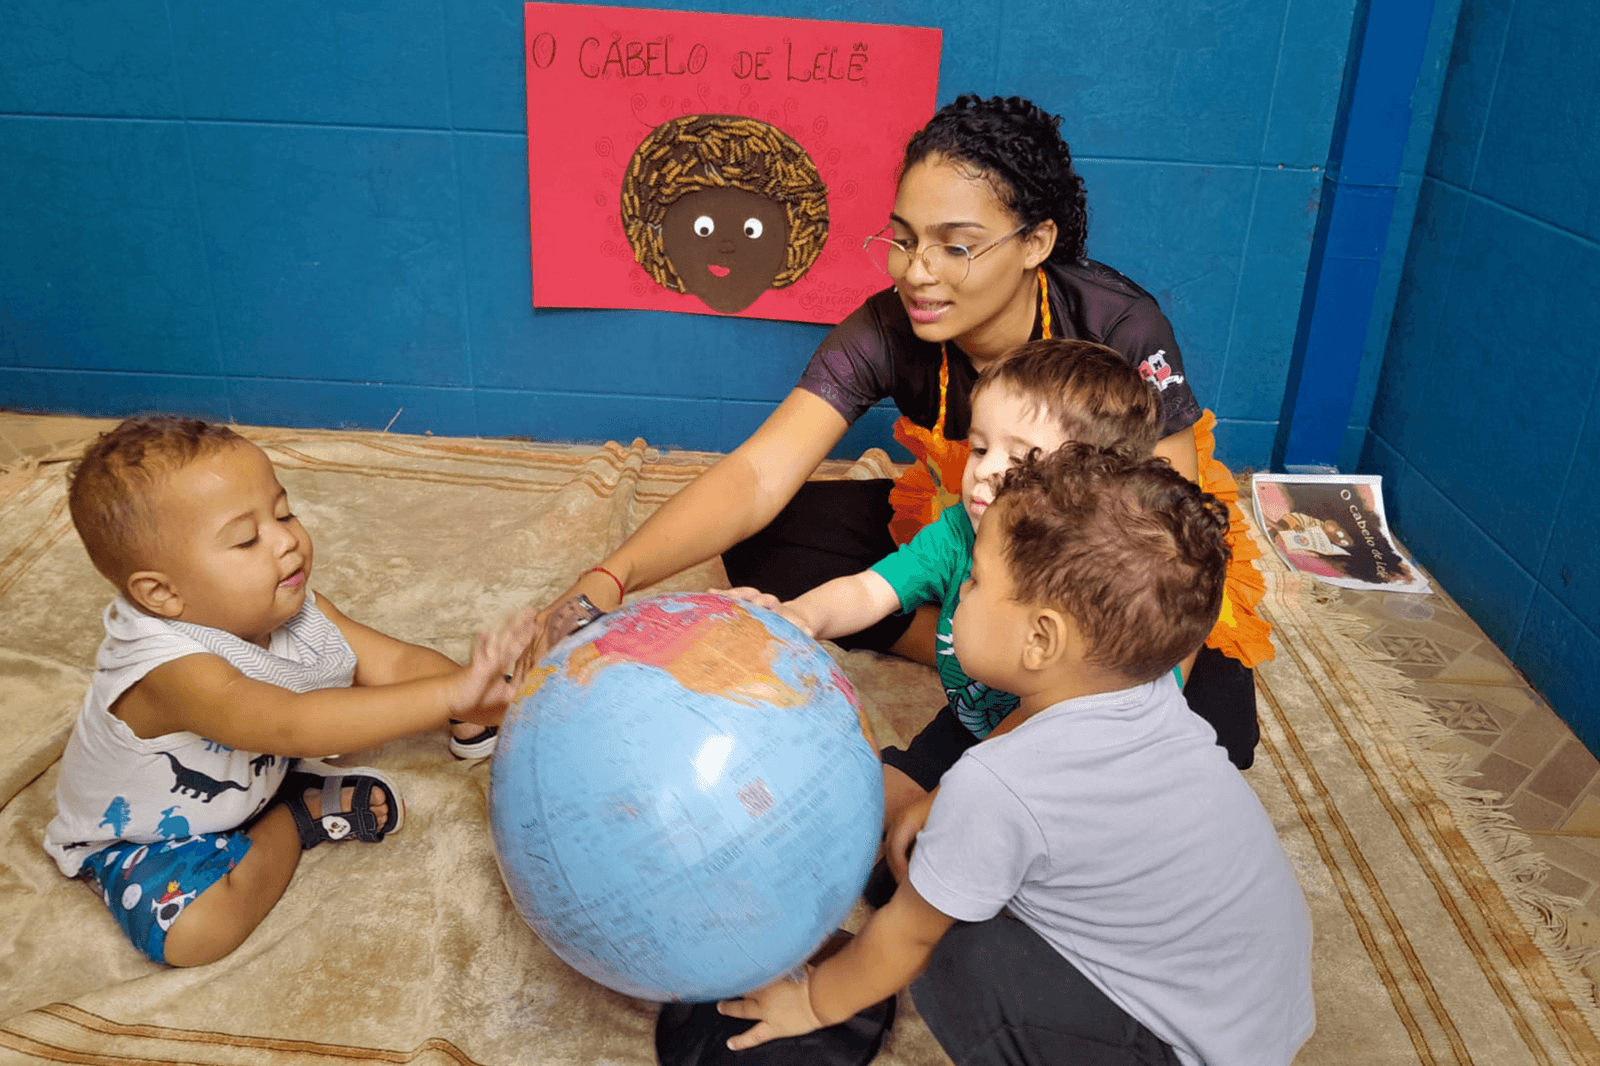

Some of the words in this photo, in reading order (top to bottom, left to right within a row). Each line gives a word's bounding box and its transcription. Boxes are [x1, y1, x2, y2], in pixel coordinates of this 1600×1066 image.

[532, 32, 556, 69] O
[579, 36, 708, 78] CABELO
[733, 51, 771, 80] DE
[1340, 489, 1351, 500] O
[1349, 504, 1375, 547] cabelo
